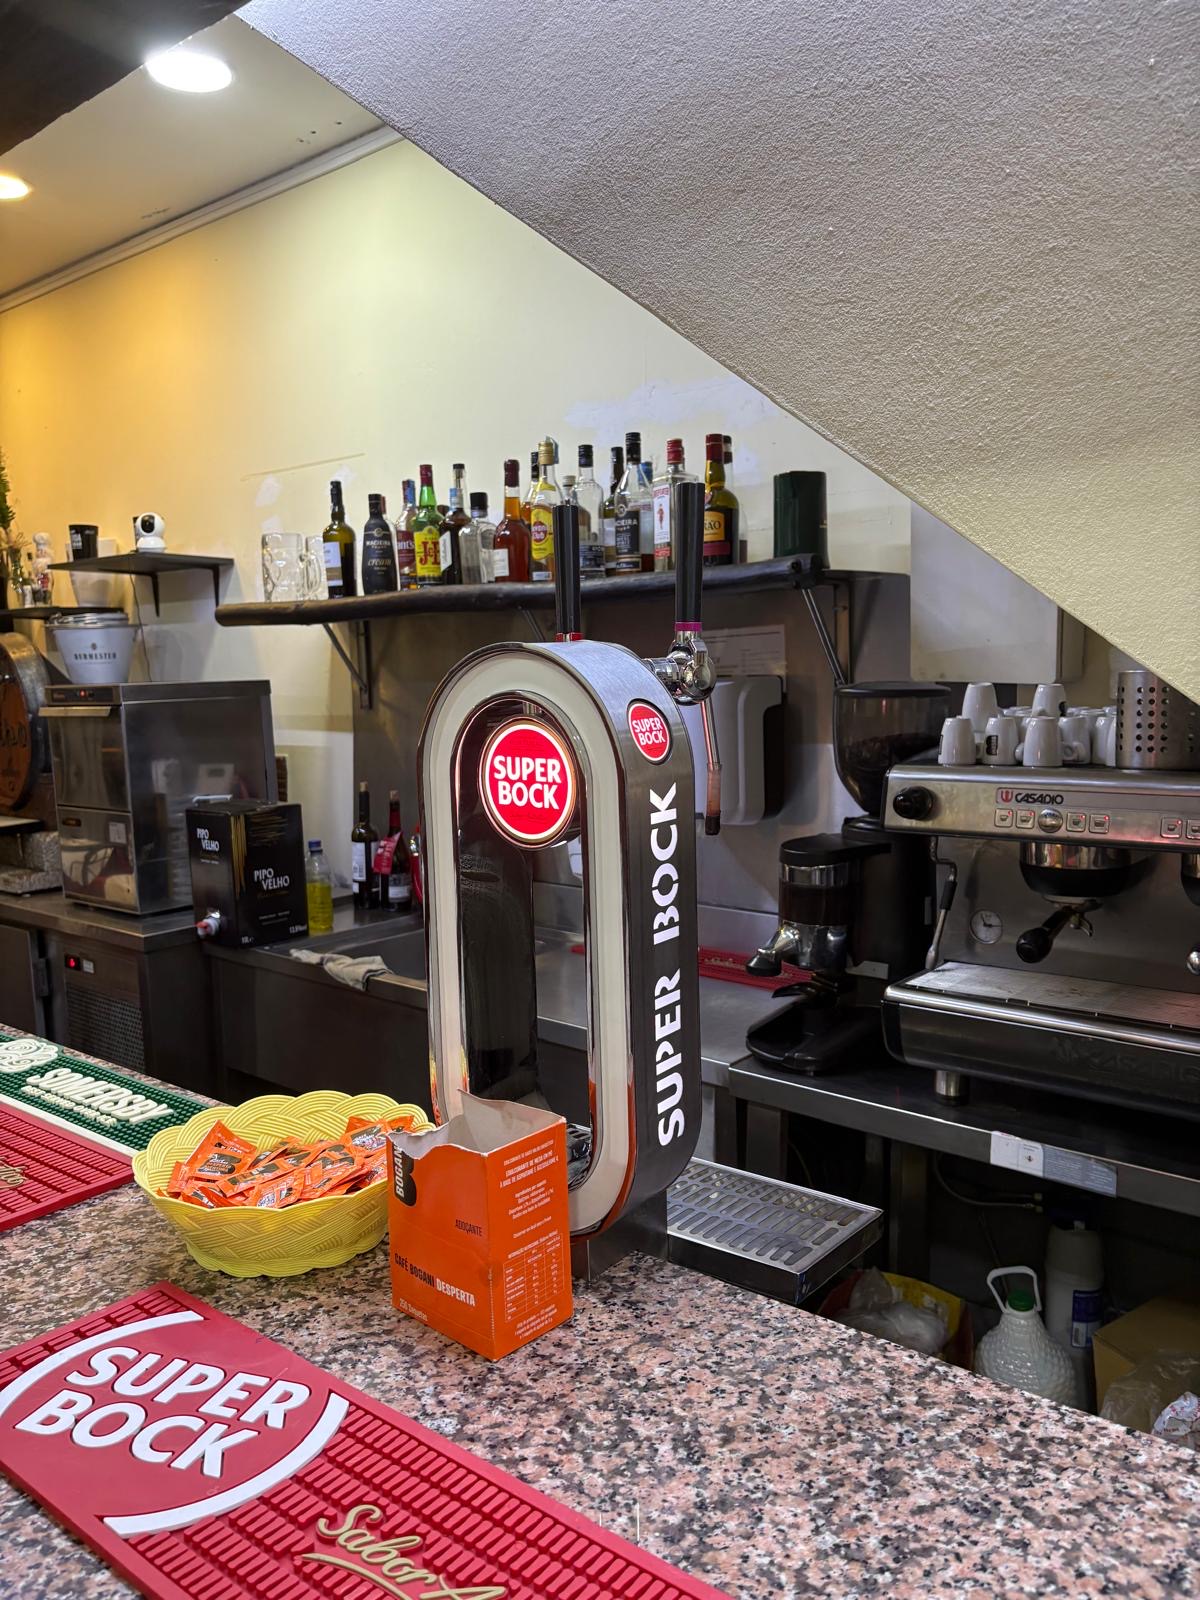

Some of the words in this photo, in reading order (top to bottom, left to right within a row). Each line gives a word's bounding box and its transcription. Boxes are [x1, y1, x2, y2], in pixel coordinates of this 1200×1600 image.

[632, 717, 663, 733] SUPER
[638, 730, 666, 746] BOCK
[493, 755, 562, 783] SUPER
[497, 780, 560, 810] BOCK
[1015, 792, 1065, 805] CASADIO
[196, 827, 210, 840] PIPO
[201, 839, 220, 852] VELHO
[254, 867, 274, 882] PIPO
[650, 782, 680, 945] BOCK
[262, 875, 290, 891] VELHO
[654, 968, 685, 1146] SUPER
[26, 1067, 174, 1125] SOMERSBY
[393, 1143, 405, 1198] BOGAN
[455, 1219, 483, 1237] ADOÇANTE
[394, 1252, 409, 1272] CAFÉ
[409, 1263, 435, 1288] BOGANI
[436, 1278, 476, 1307] DESPERTA
[65, 1345, 311, 1431] SUPER
[14, 1389, 259, 1479] BOCK
[316, 1504, 438, 1585] Sabor
